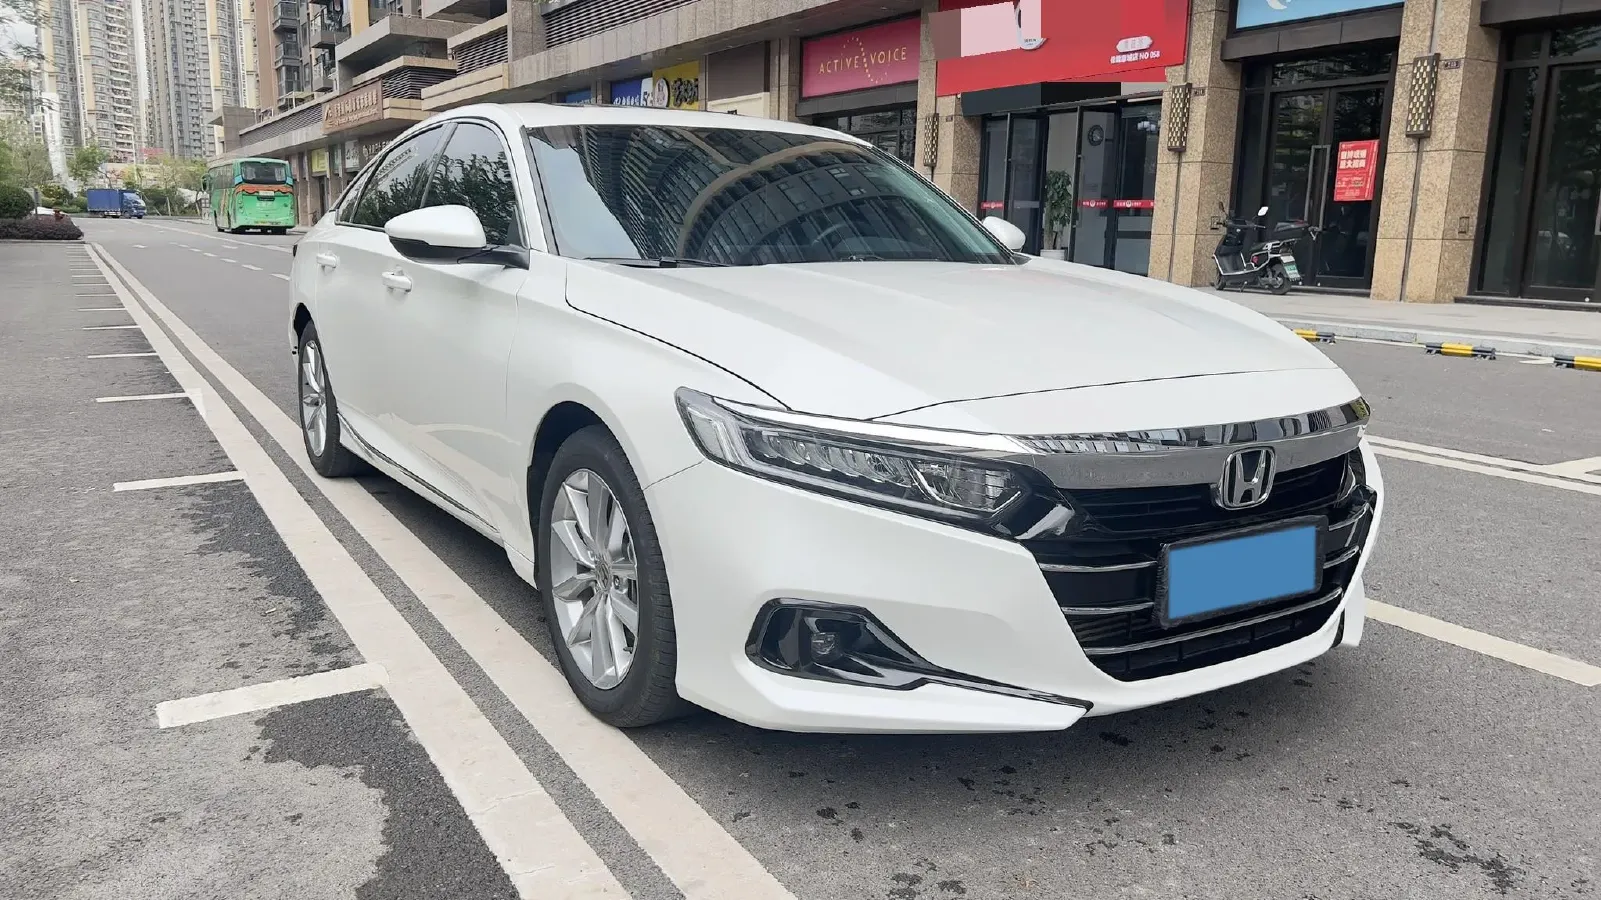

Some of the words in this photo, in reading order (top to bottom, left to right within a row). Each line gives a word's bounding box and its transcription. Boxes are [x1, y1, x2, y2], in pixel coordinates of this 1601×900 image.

[818, 55, 860, 75] ACTIVE
[870, 47, 907, 65] VOICE
[1139, 51, 1149, 60] NO
